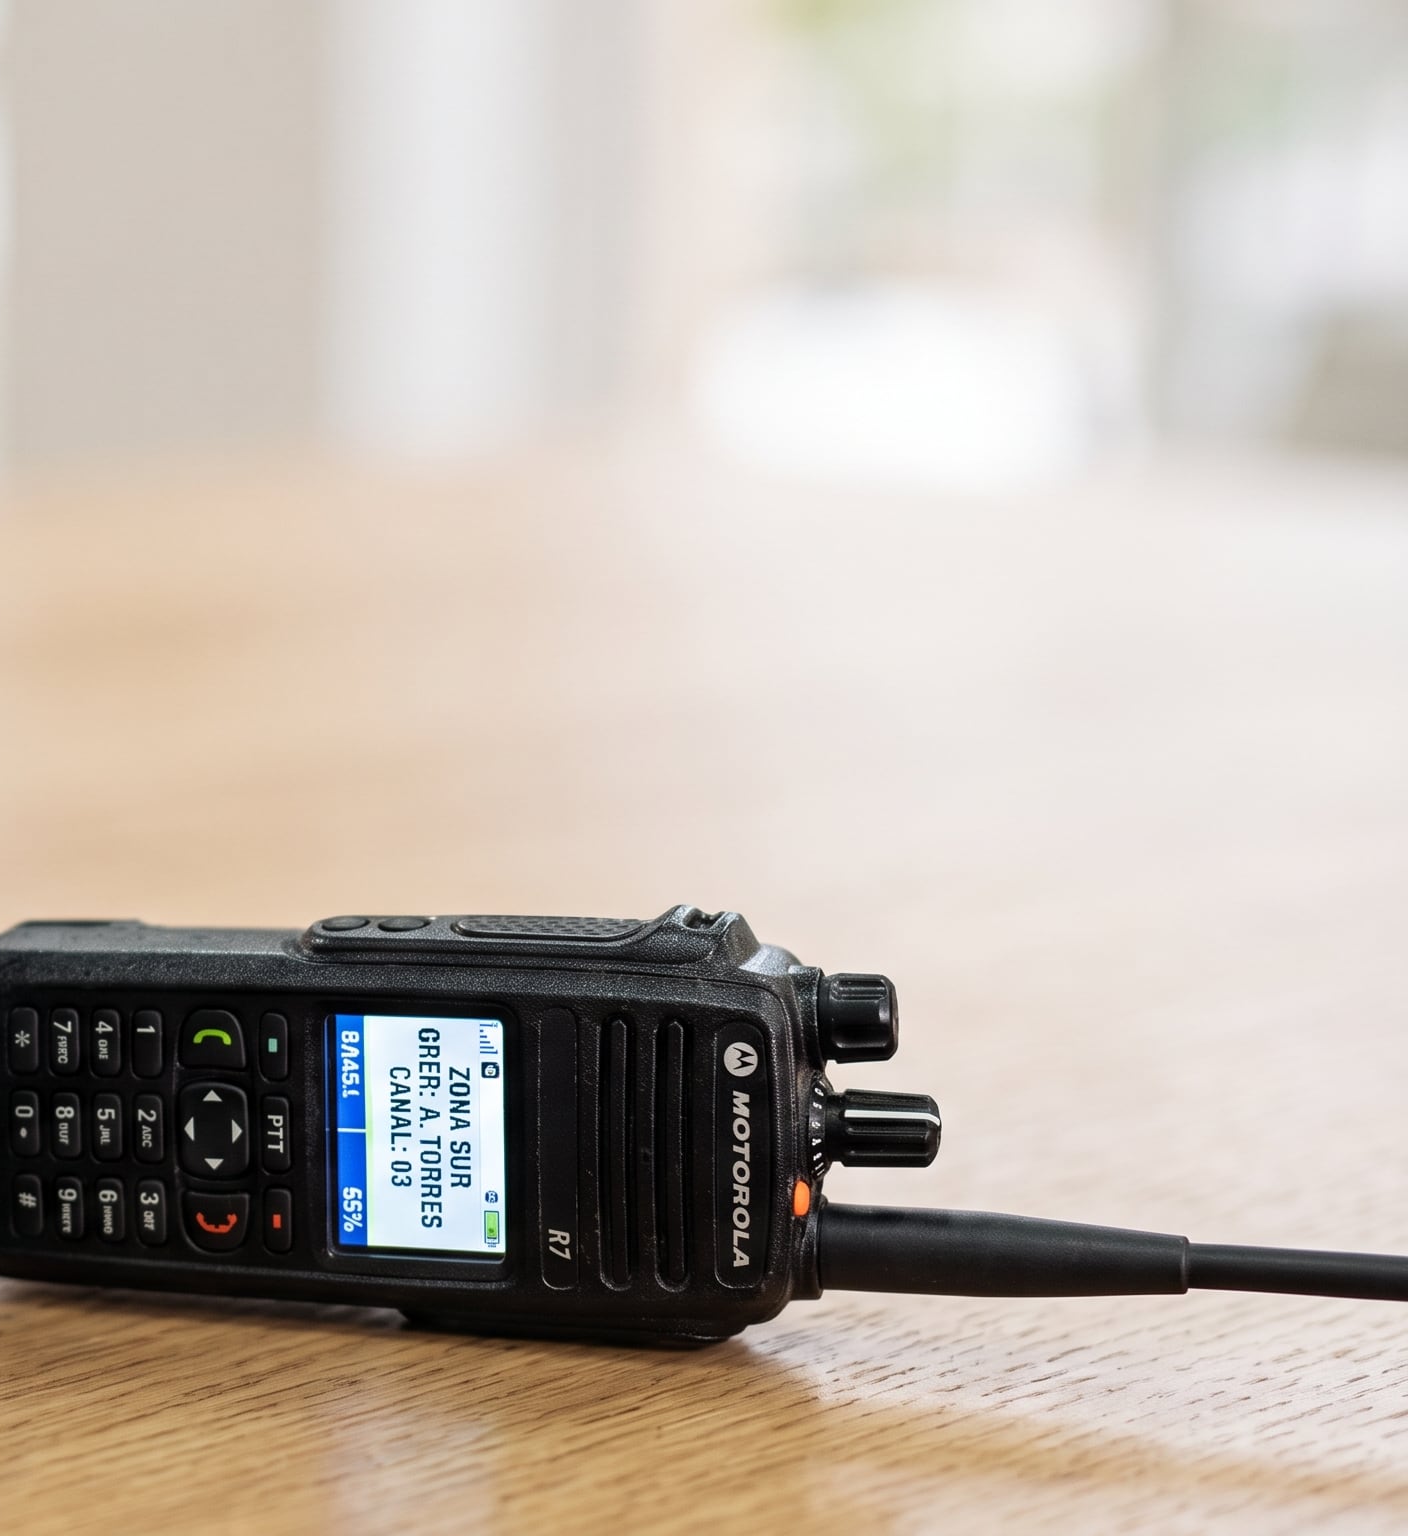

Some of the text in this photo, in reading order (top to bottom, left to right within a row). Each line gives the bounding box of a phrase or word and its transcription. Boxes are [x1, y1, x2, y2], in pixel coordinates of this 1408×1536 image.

[53, 1020, 72, 1033] 7
[95, 1021, 113, 1034] 4
[136, 1025, 155, 1033] 1
[15, 1105, 33, 1118] 0
[55, 1106, 74, 1119] 8
[97, 1108, 115, 1120] 5
[138, 1109, 157, 1122] 2
[419, 1107, 441, 1129] A.
[267, 1114, 284, 1153] PTT
[390, 1067, 412, 1187] CANAL: 03
[449, 1067, 472, 1188] ZONA SUR
[419, 1135, 442, 1228] TORRES
[732, 1090, 750, 1268] MOTOROLA
[58, 1188, 77, 1200] 9
[98, 1189, 117, 1202] 6
[140, 1192, 159, 1205] 3
[548, 1228, 572, 1261] R7
